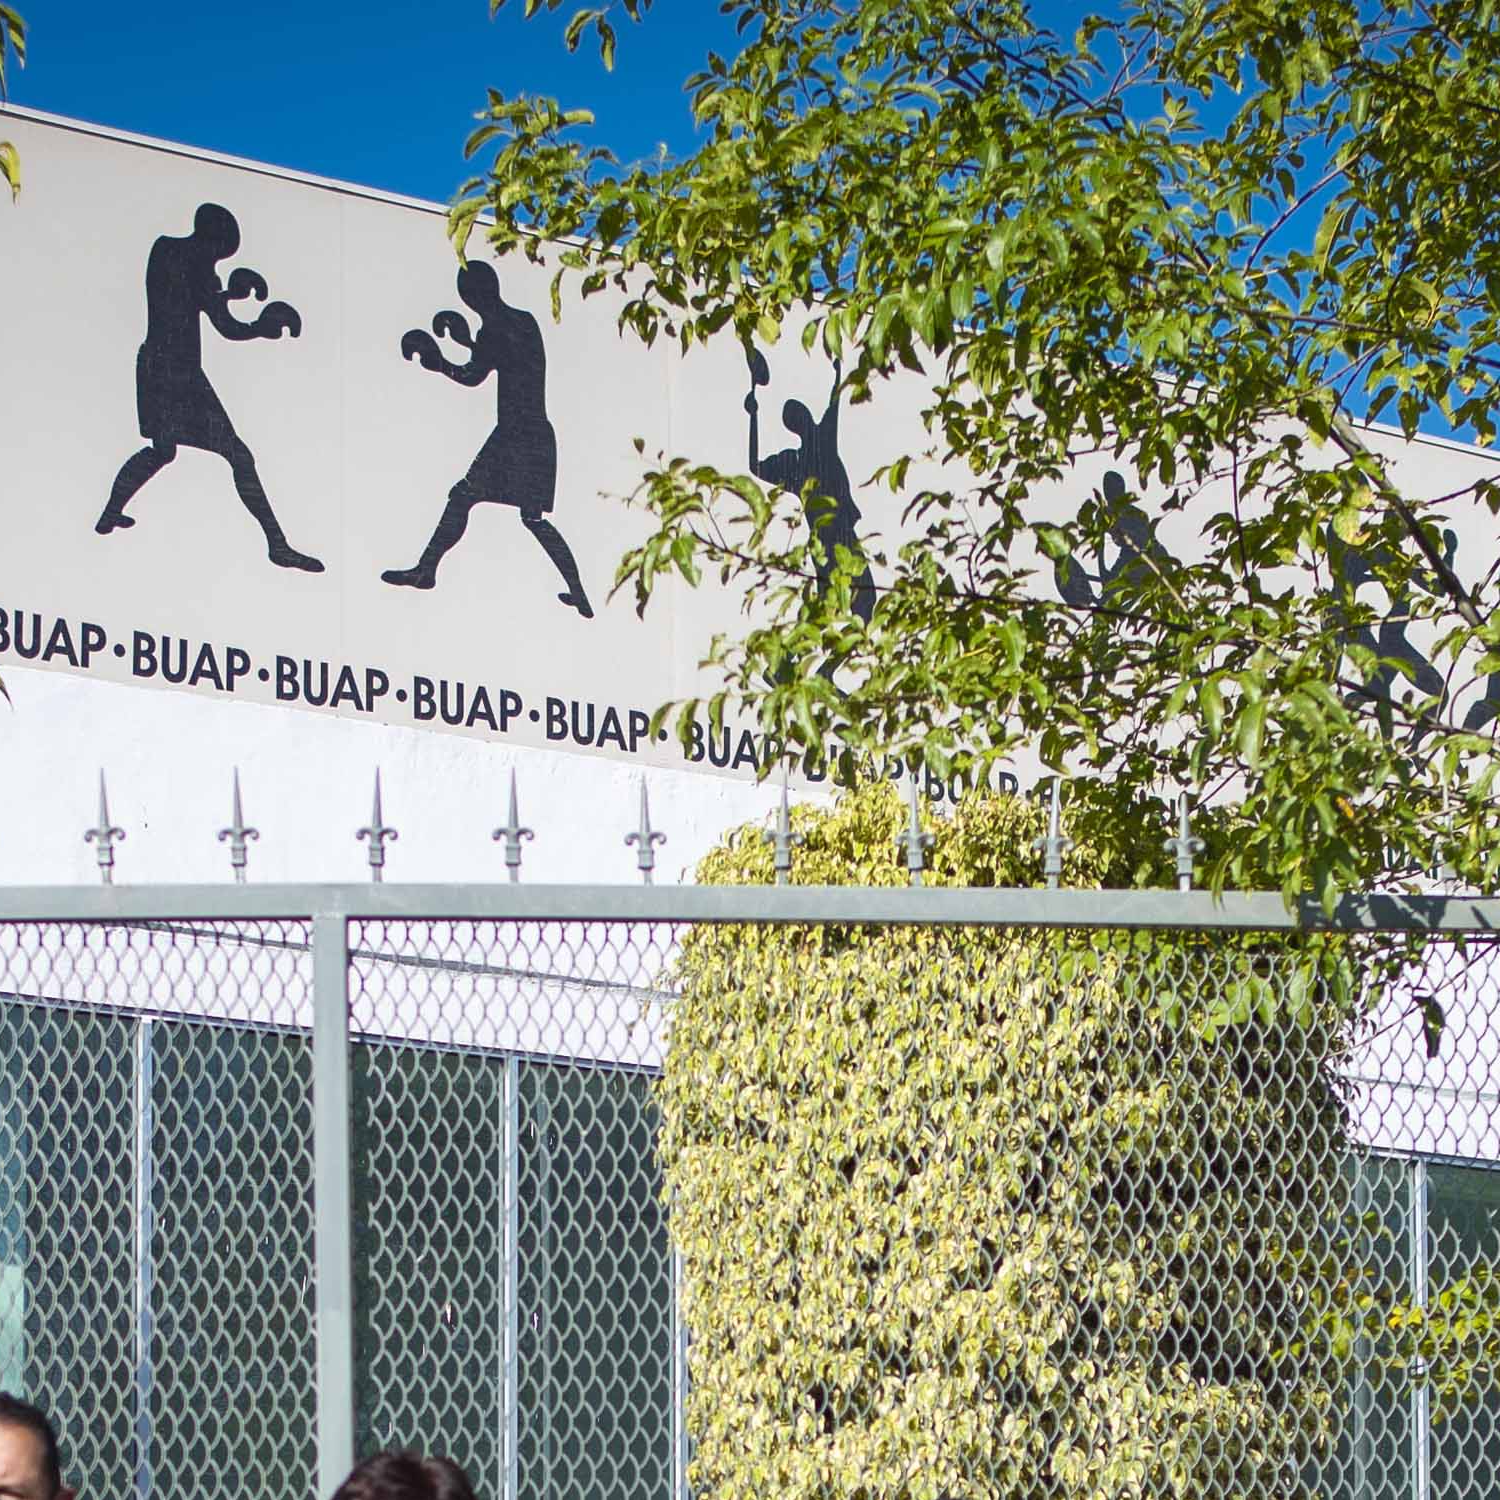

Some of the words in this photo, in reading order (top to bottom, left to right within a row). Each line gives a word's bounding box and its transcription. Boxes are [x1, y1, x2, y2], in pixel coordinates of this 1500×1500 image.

[132, 630, 252, 692] BUAP
[275, 655, 390, 713] BUAP
[413, 676, 523, 732] BUAP
[545, 696, 651, 753] BUAP
